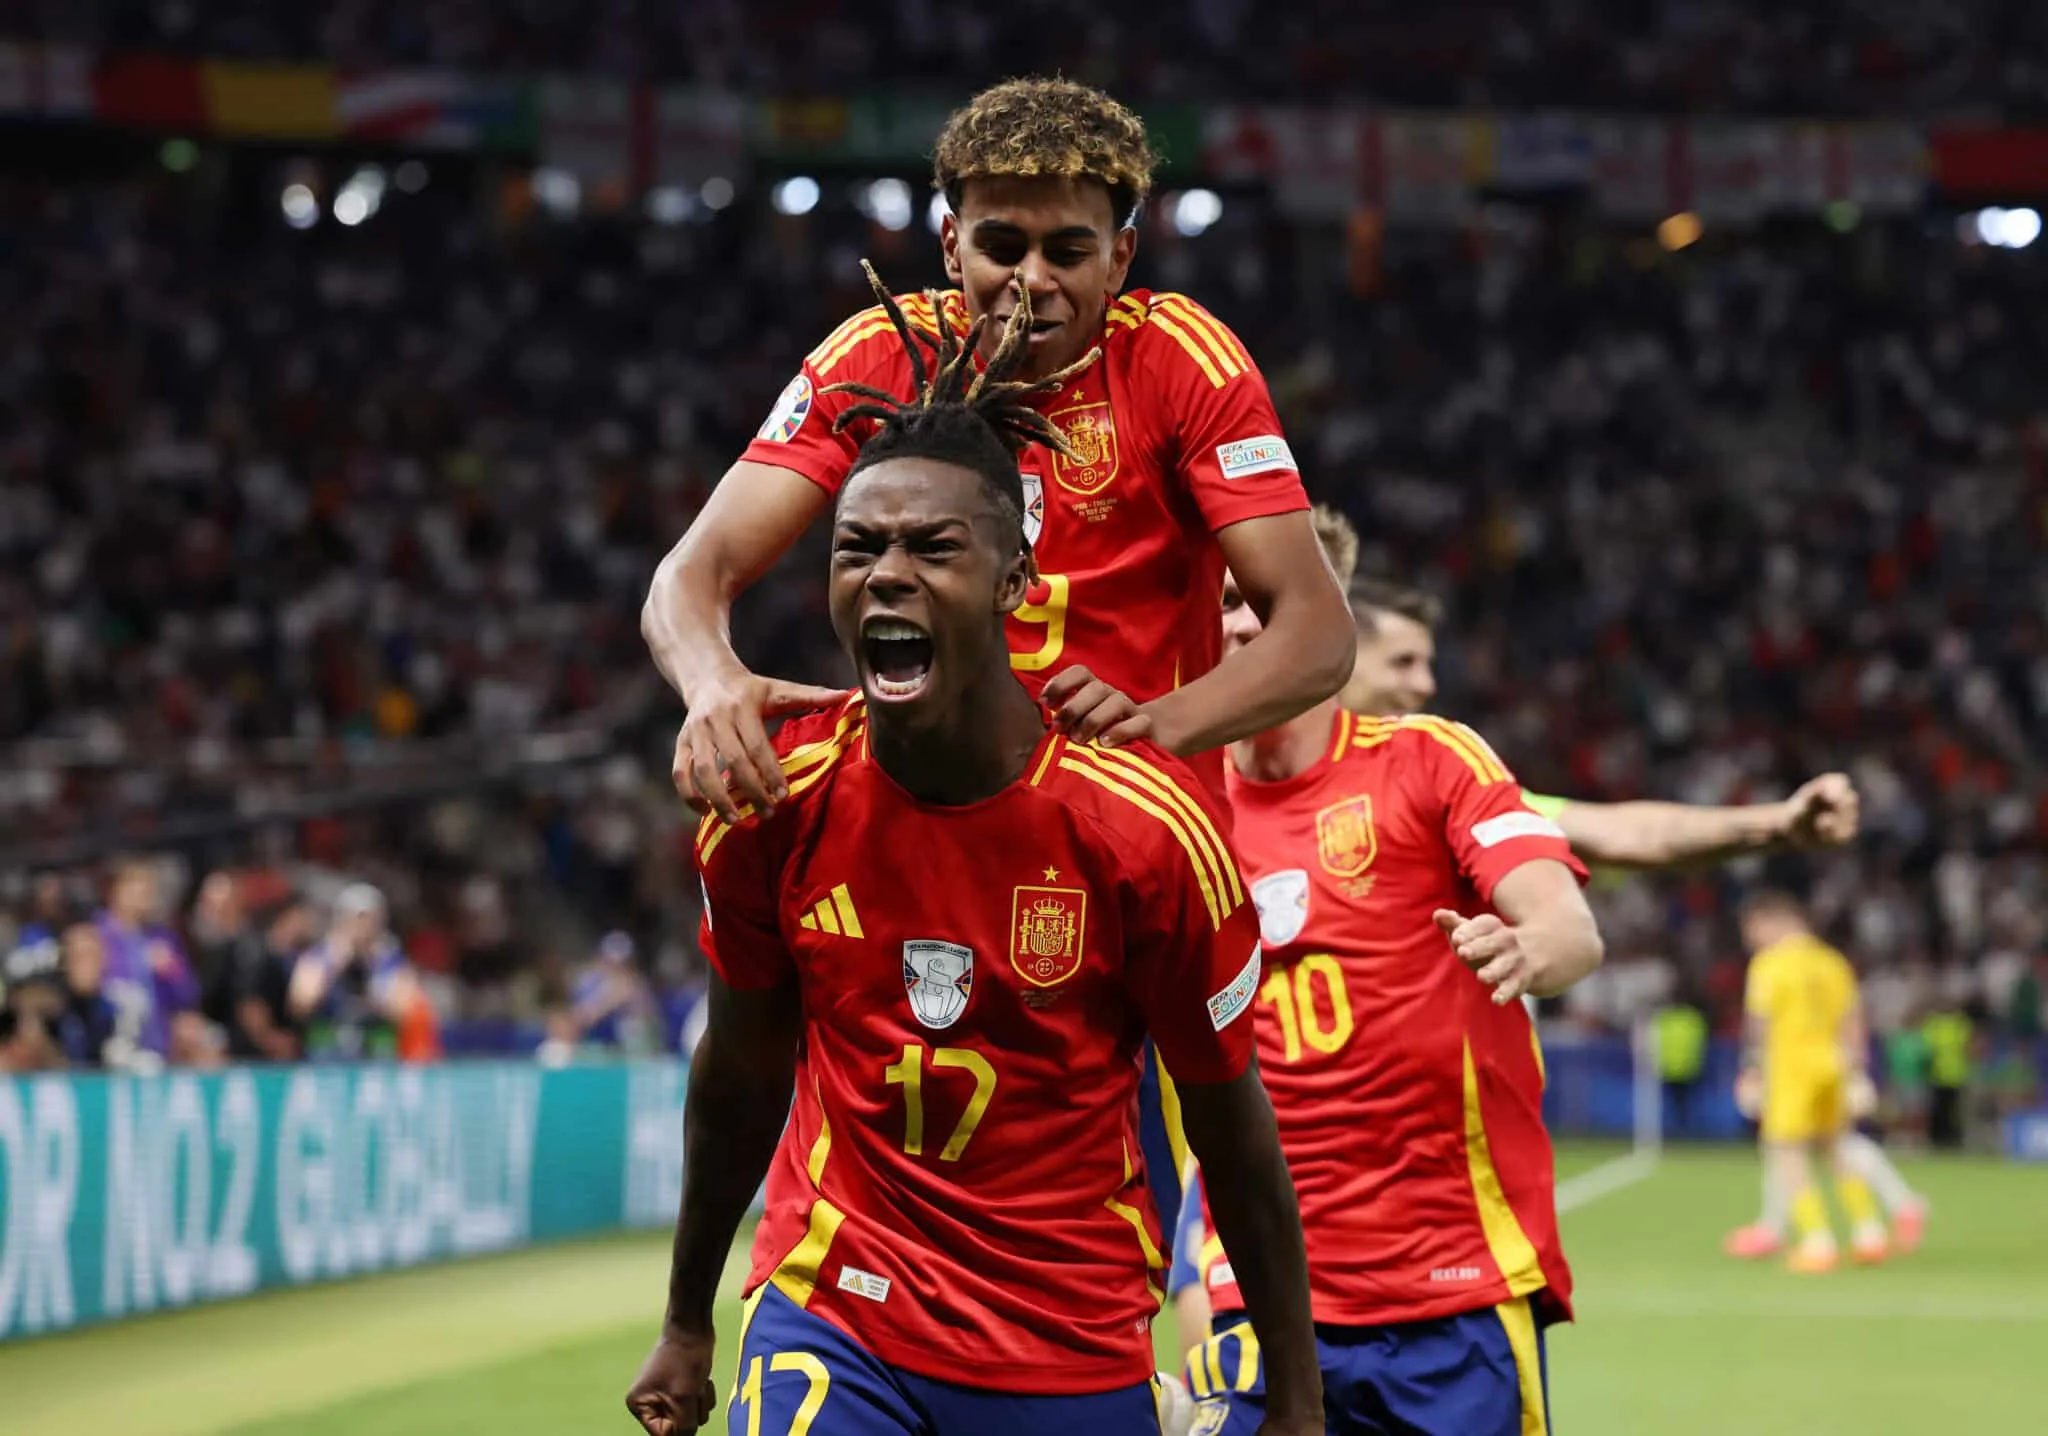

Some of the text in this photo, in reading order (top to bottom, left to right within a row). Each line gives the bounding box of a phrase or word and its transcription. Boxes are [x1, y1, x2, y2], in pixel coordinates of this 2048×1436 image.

[1261, 954, 1354, 1062] 10
[886, 1044, 997, 1162] 17
[741, 1352, 830, 1436] 17
